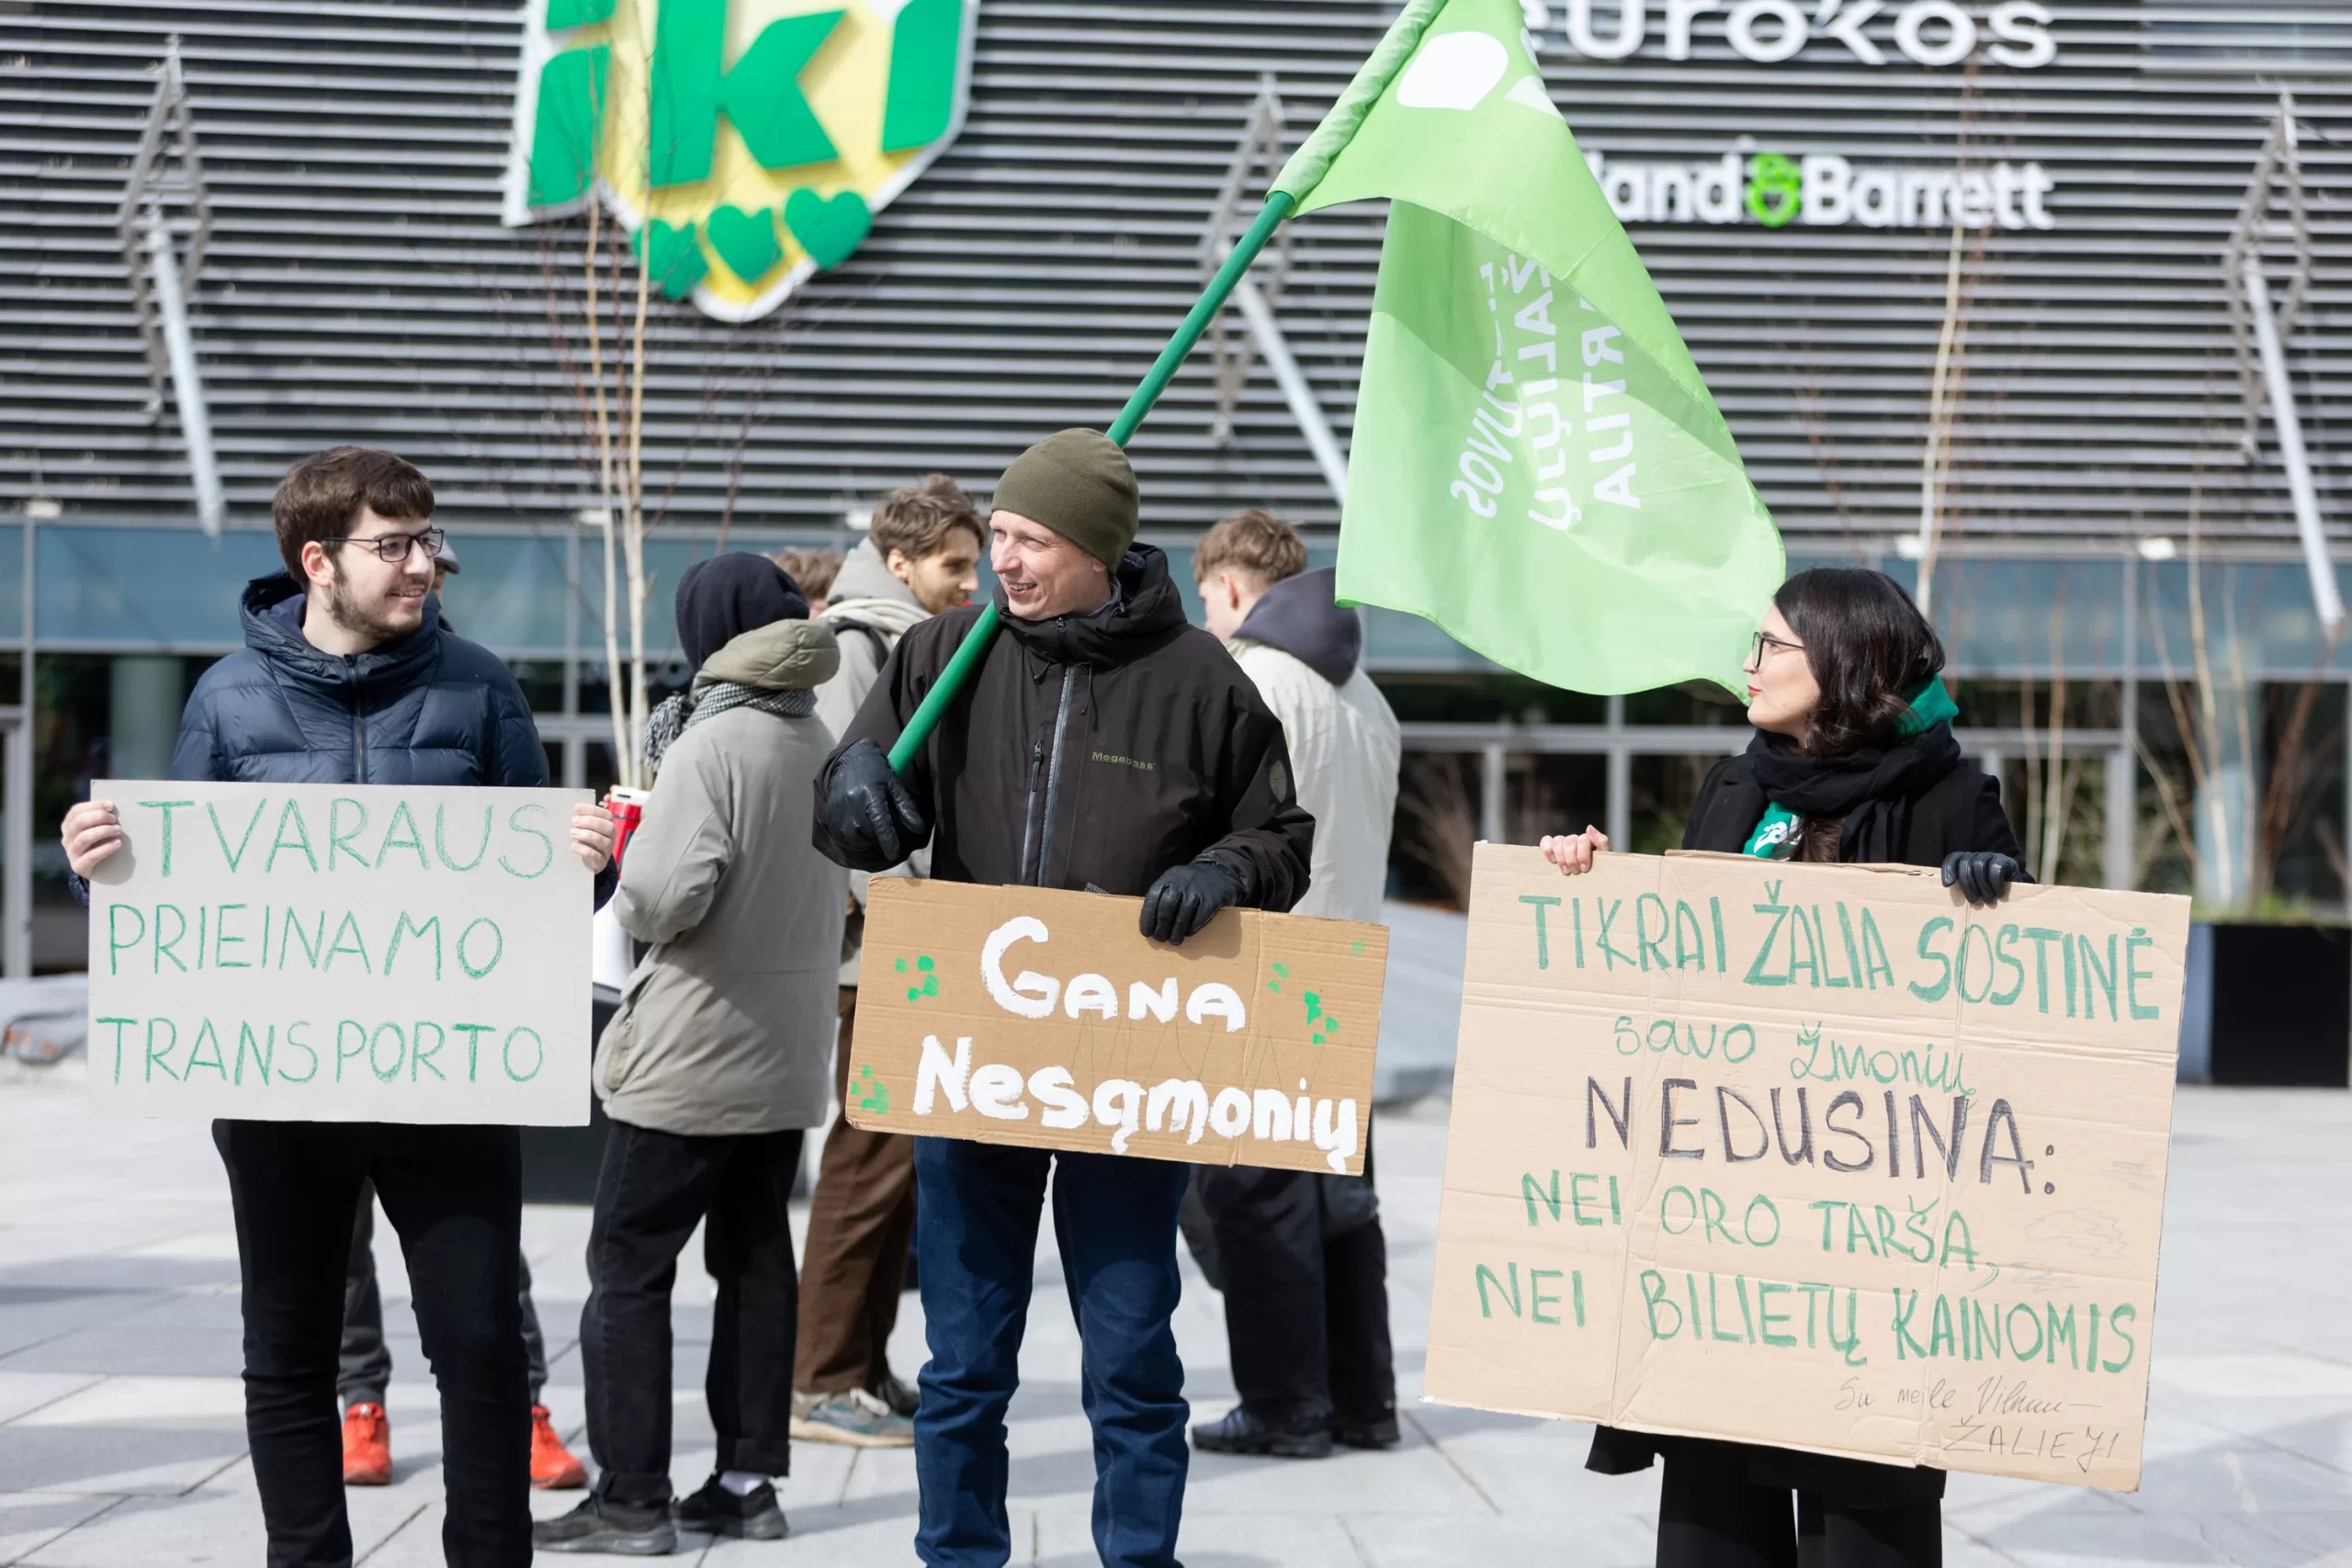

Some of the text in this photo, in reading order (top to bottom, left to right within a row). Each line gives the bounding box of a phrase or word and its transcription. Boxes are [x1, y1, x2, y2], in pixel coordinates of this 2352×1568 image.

[527, 0, 962, 207] iki
[137, 797, 554, 879] TVARAUS
[109, 904, 503, 981] PRIEINAMO
[1518, 879, 2161, 1021] TIKRAI ŽALIA SOSTINĖ
[96, 1017, 543, 1088] TRANSPORTO
[1613, 1015, 1757, 1064] savo
[1584, 1076, 2057, 1196] NEDUSINA:
[1521, 1170, 2001, 1290] NEI ORO TARŠA,
[1475, 1261, 2138, 1374] NEI BILIETŲ KAINOMIS
[1835, 1376, 1877, 1411] Su
